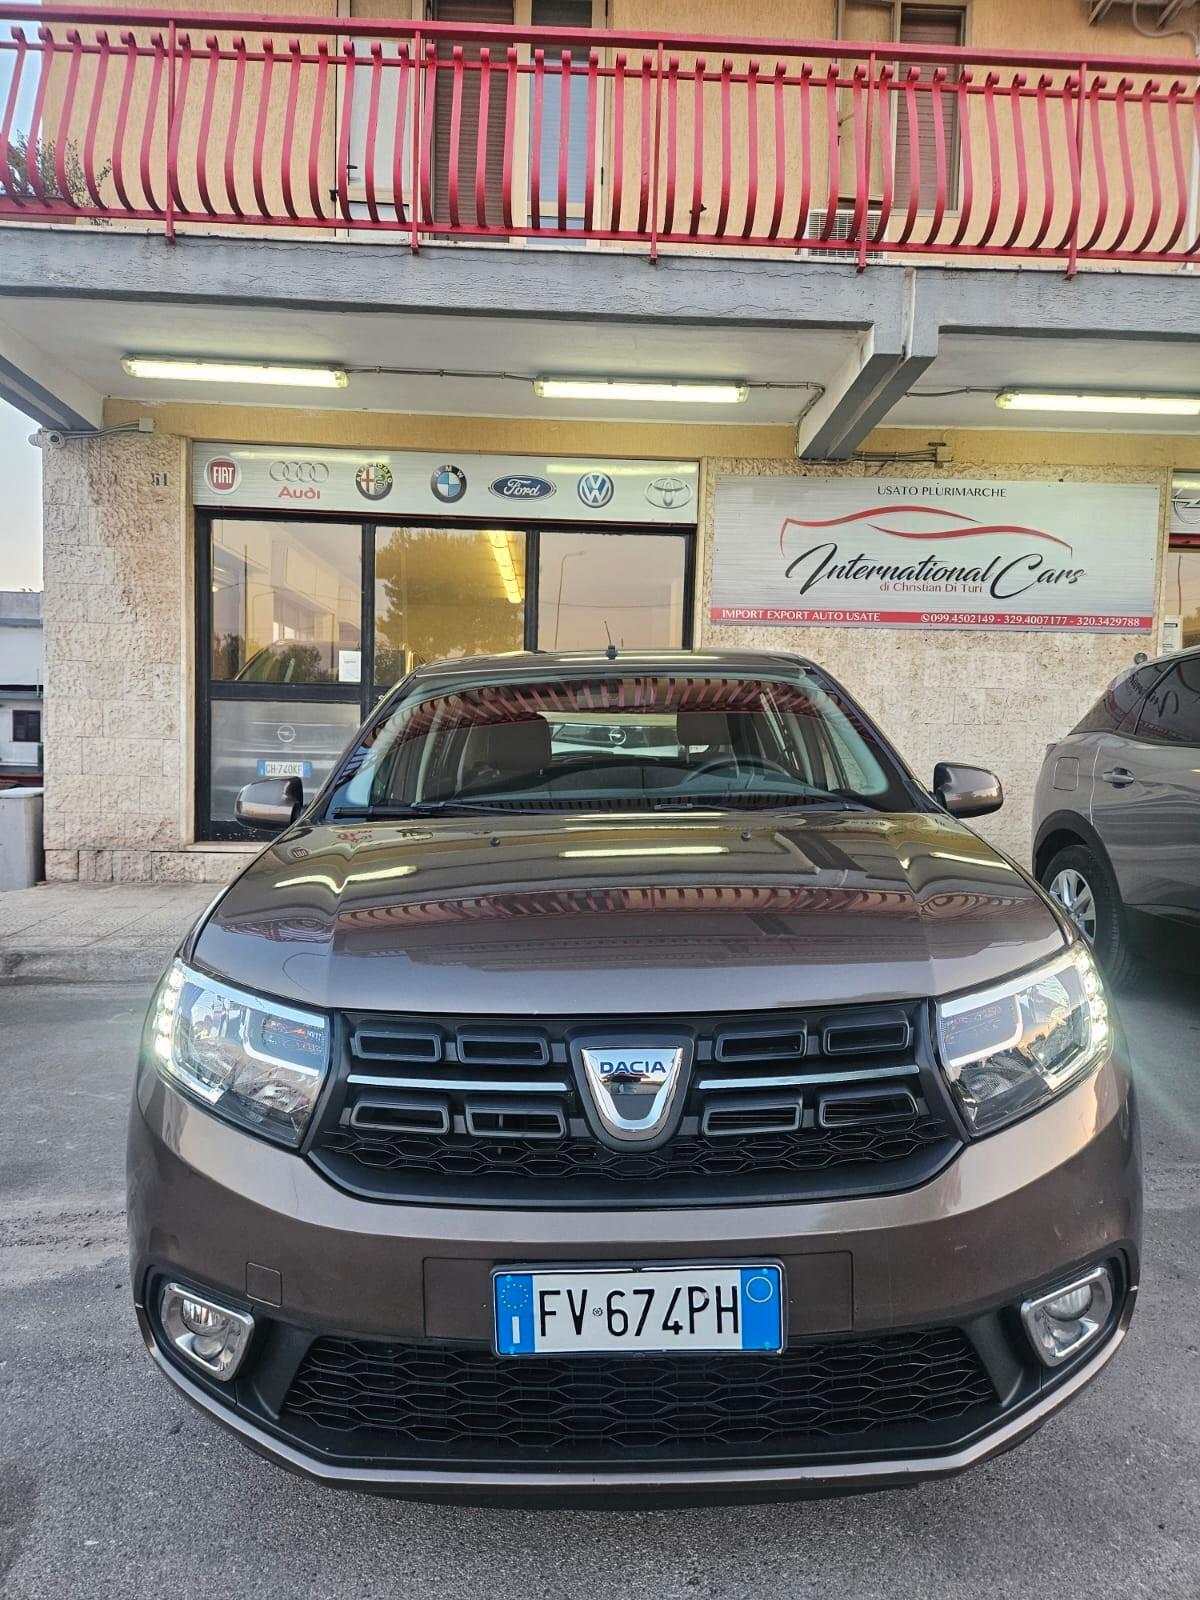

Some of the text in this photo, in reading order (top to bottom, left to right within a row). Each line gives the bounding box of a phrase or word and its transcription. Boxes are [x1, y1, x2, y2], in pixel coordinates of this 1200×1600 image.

[213, 466, 234, 484] FIAT
[433, 464, 465, 480] BMW
[277, 486, 321, 500] Audi
[503, 478, 541, 497] Ford
[877, 486, 1007, 498] USATO PLURIMARCHE
[785, 542, 1088, 599] International Cars
[879, 581, 983, 593] di Christian Di Turi
[722, 609, 881, 622] IMPORT EXPORT AUTO USATE
[930, 614, 995, 624] 099.4502149
[1004, 615, 1067, 625] 329.4007177
[1076, 616, 1140, 627] 320.3429788
[599, 1061, 666, 1075] DACIA
[538, 1289, 588, 1337] FV
[605, 1285, 739, 1337] 674PH
